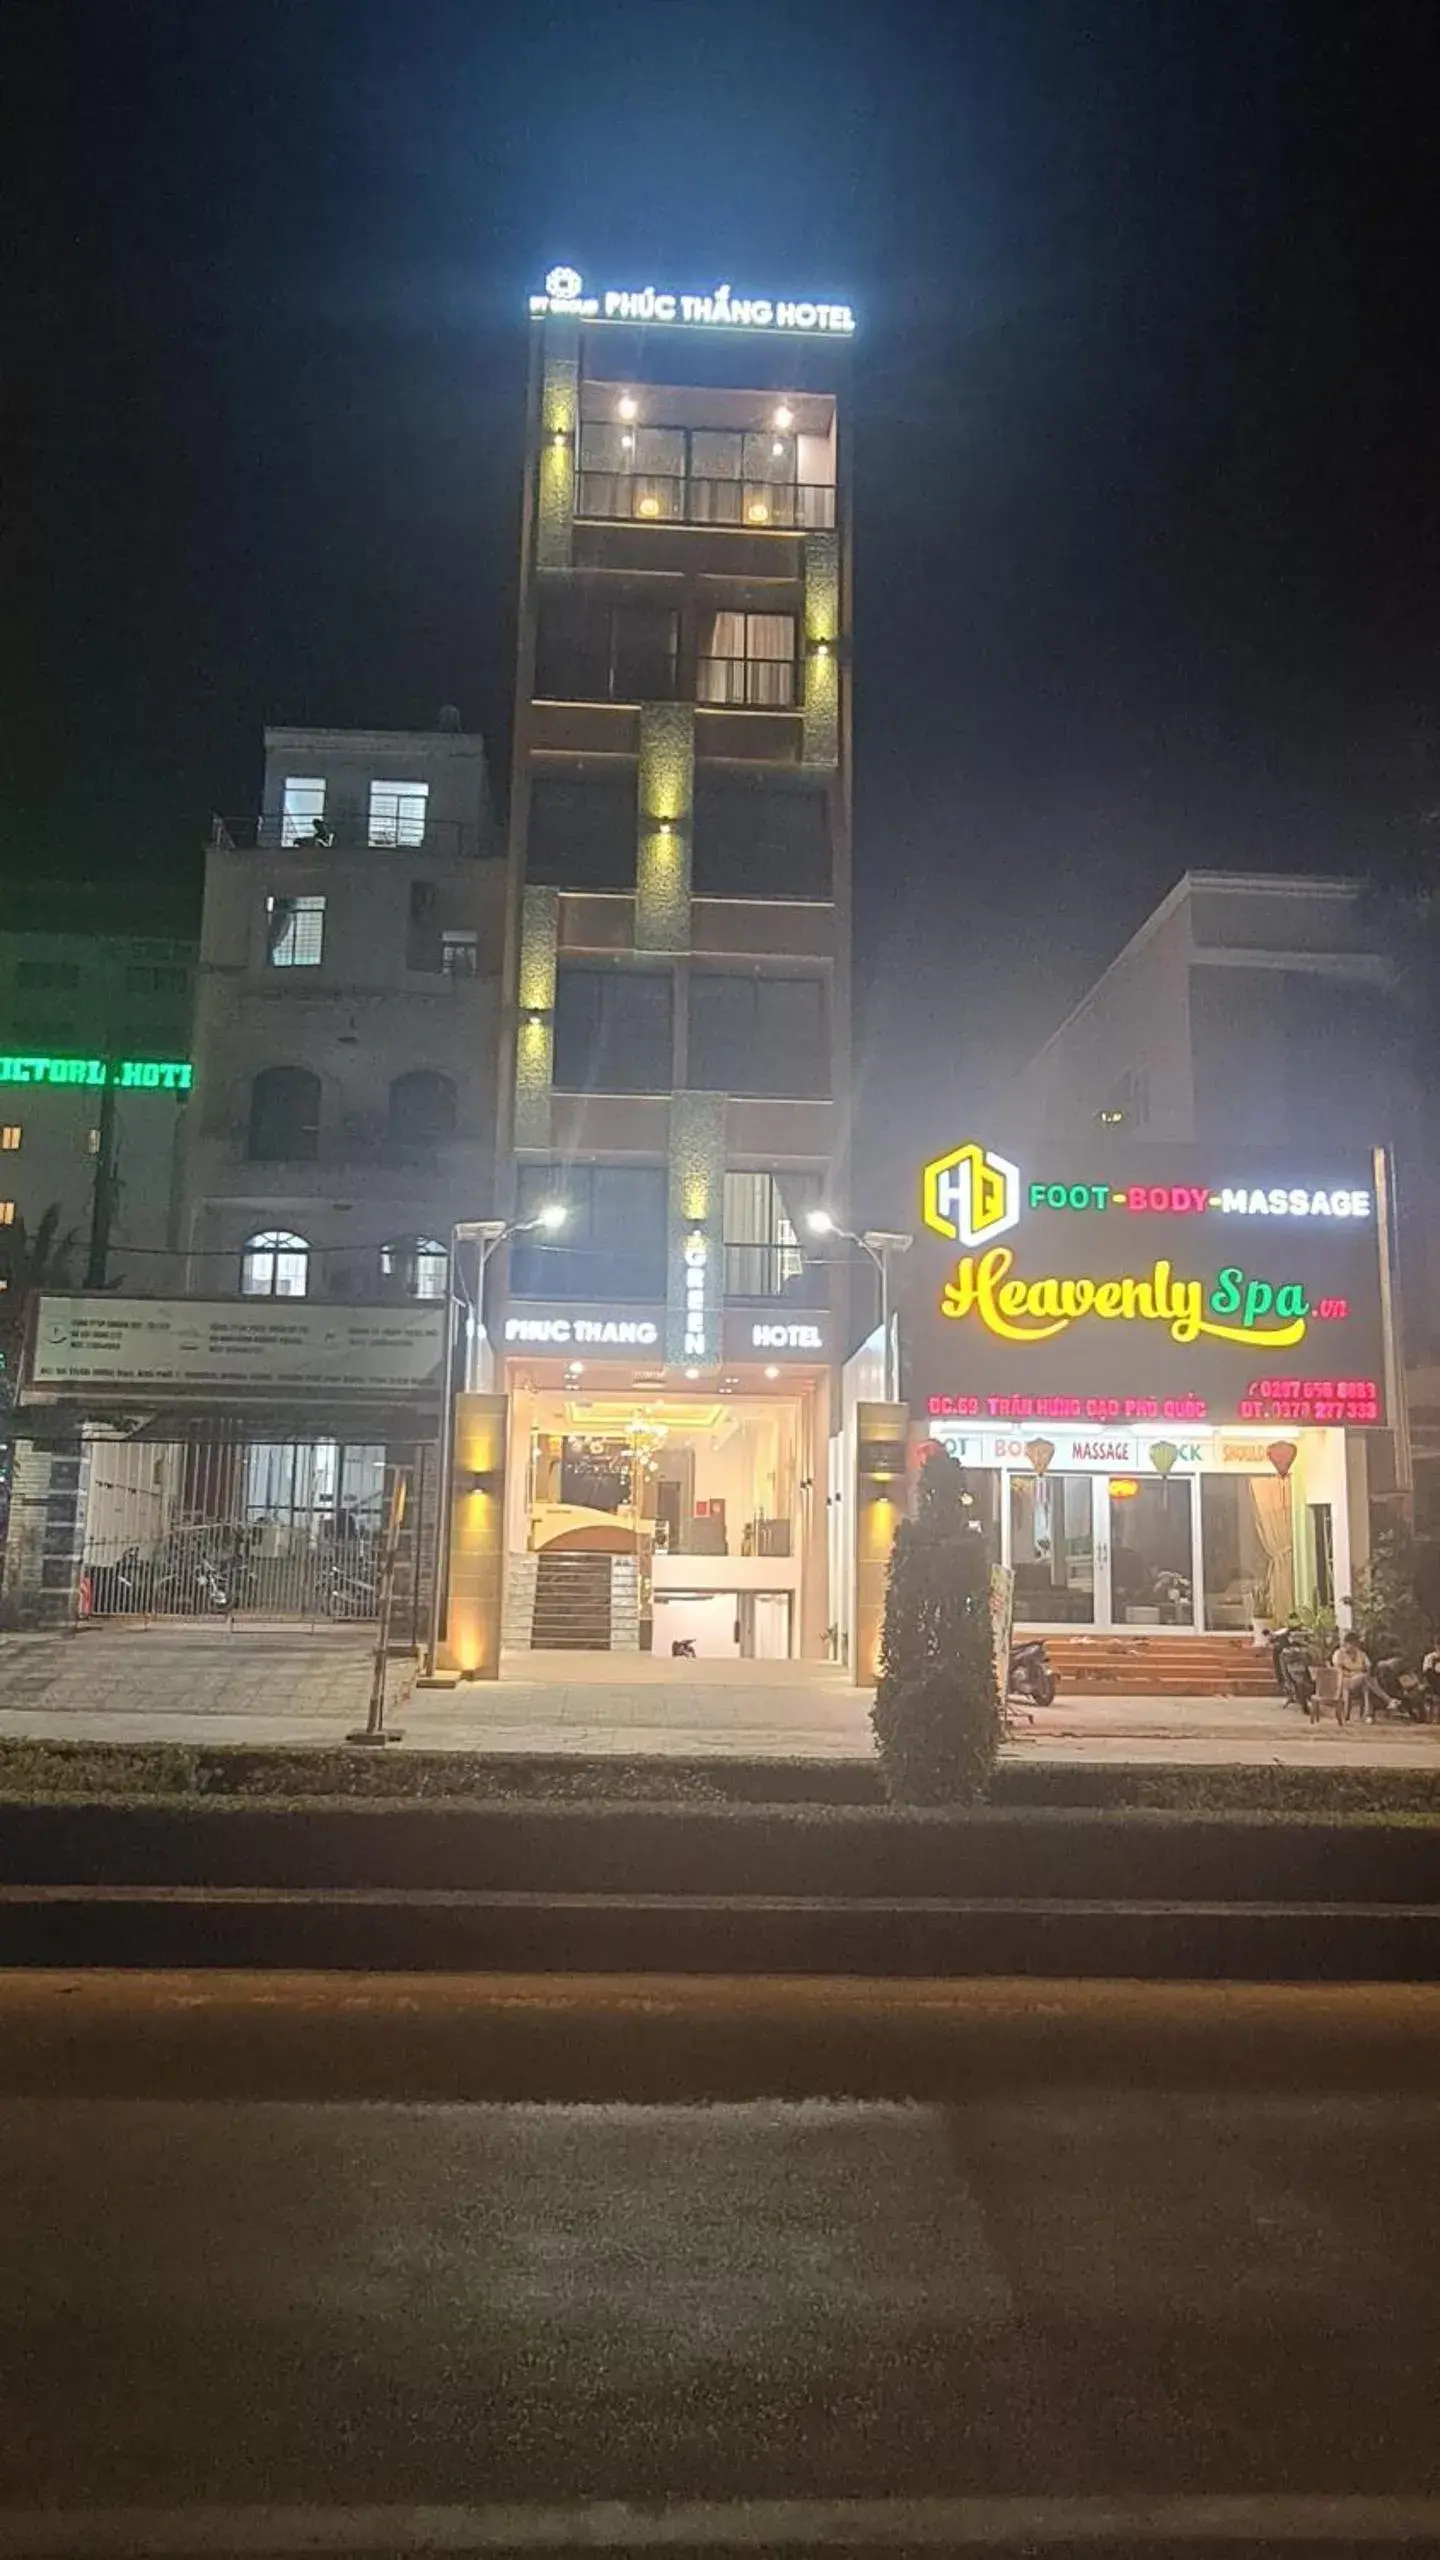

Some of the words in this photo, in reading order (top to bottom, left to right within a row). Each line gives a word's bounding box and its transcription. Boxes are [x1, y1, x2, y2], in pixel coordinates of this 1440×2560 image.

[605, 286, 676, 319] PHÚC
[776, 302, 855, 332] HOTEL
[941, 1247, 1304, 1346] Heavenly
[505, 1319, 571, 1343] PHUC
[573, 1320, 657, 1344] THANG
[753, 1324, 823, 1348] HOTEL
[1072, 1442, 1129, 1461] MASSAGE
